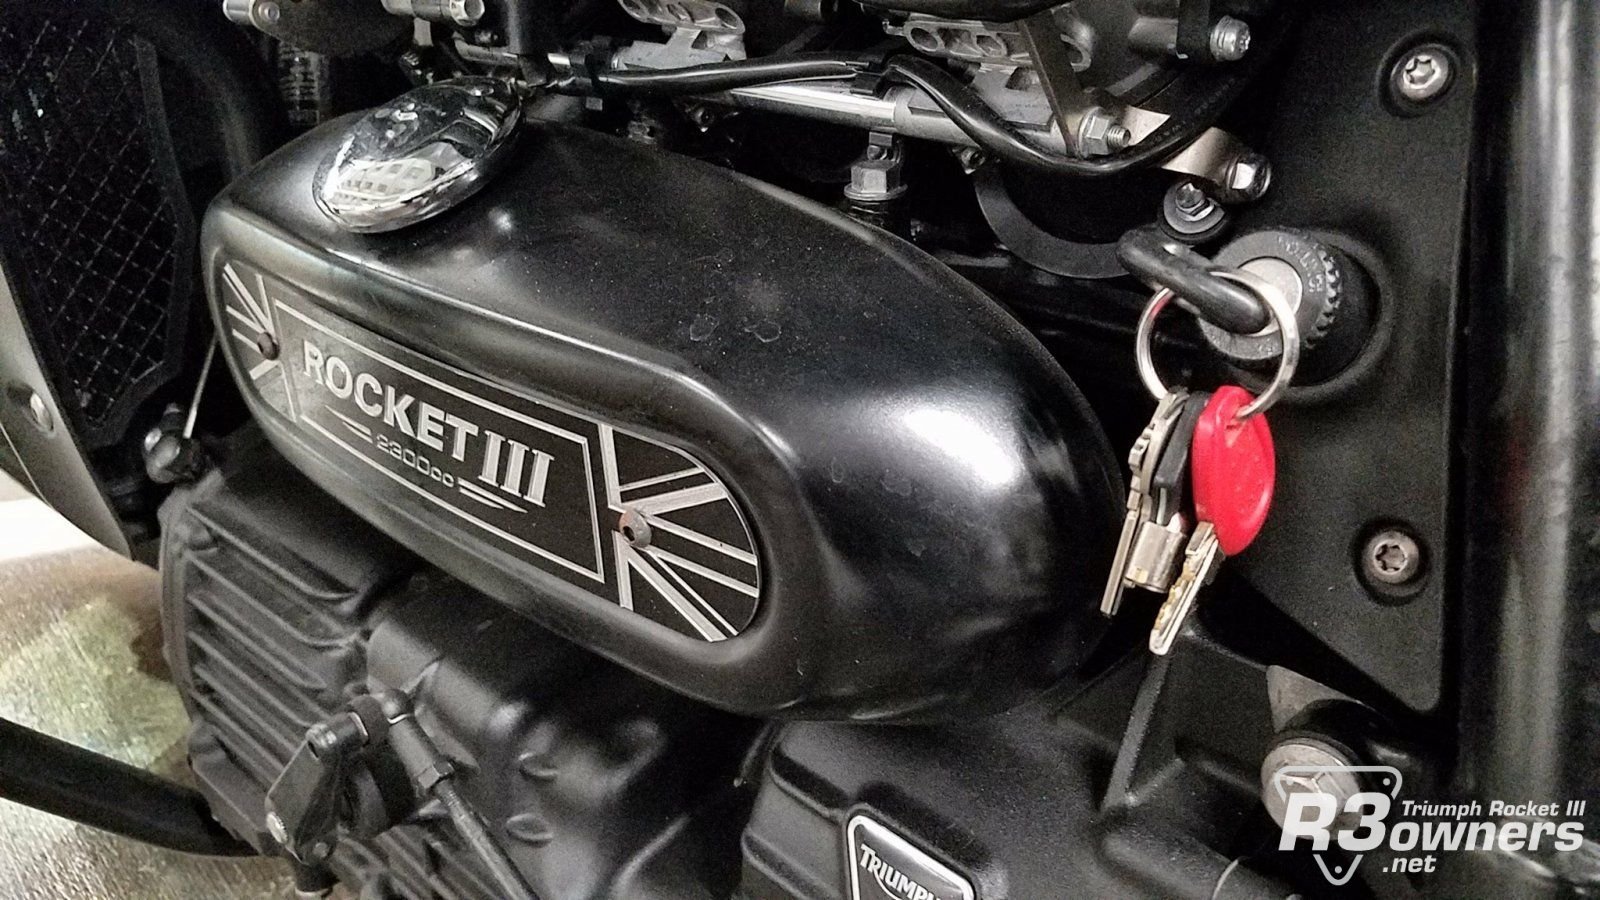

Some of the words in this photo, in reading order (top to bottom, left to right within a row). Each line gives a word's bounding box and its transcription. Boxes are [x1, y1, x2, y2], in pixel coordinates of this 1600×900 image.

[303, 340, 479, 462] ROCKET
[478, 430, 555, 508] III
[376, 434, 455, 488] 2300cc
